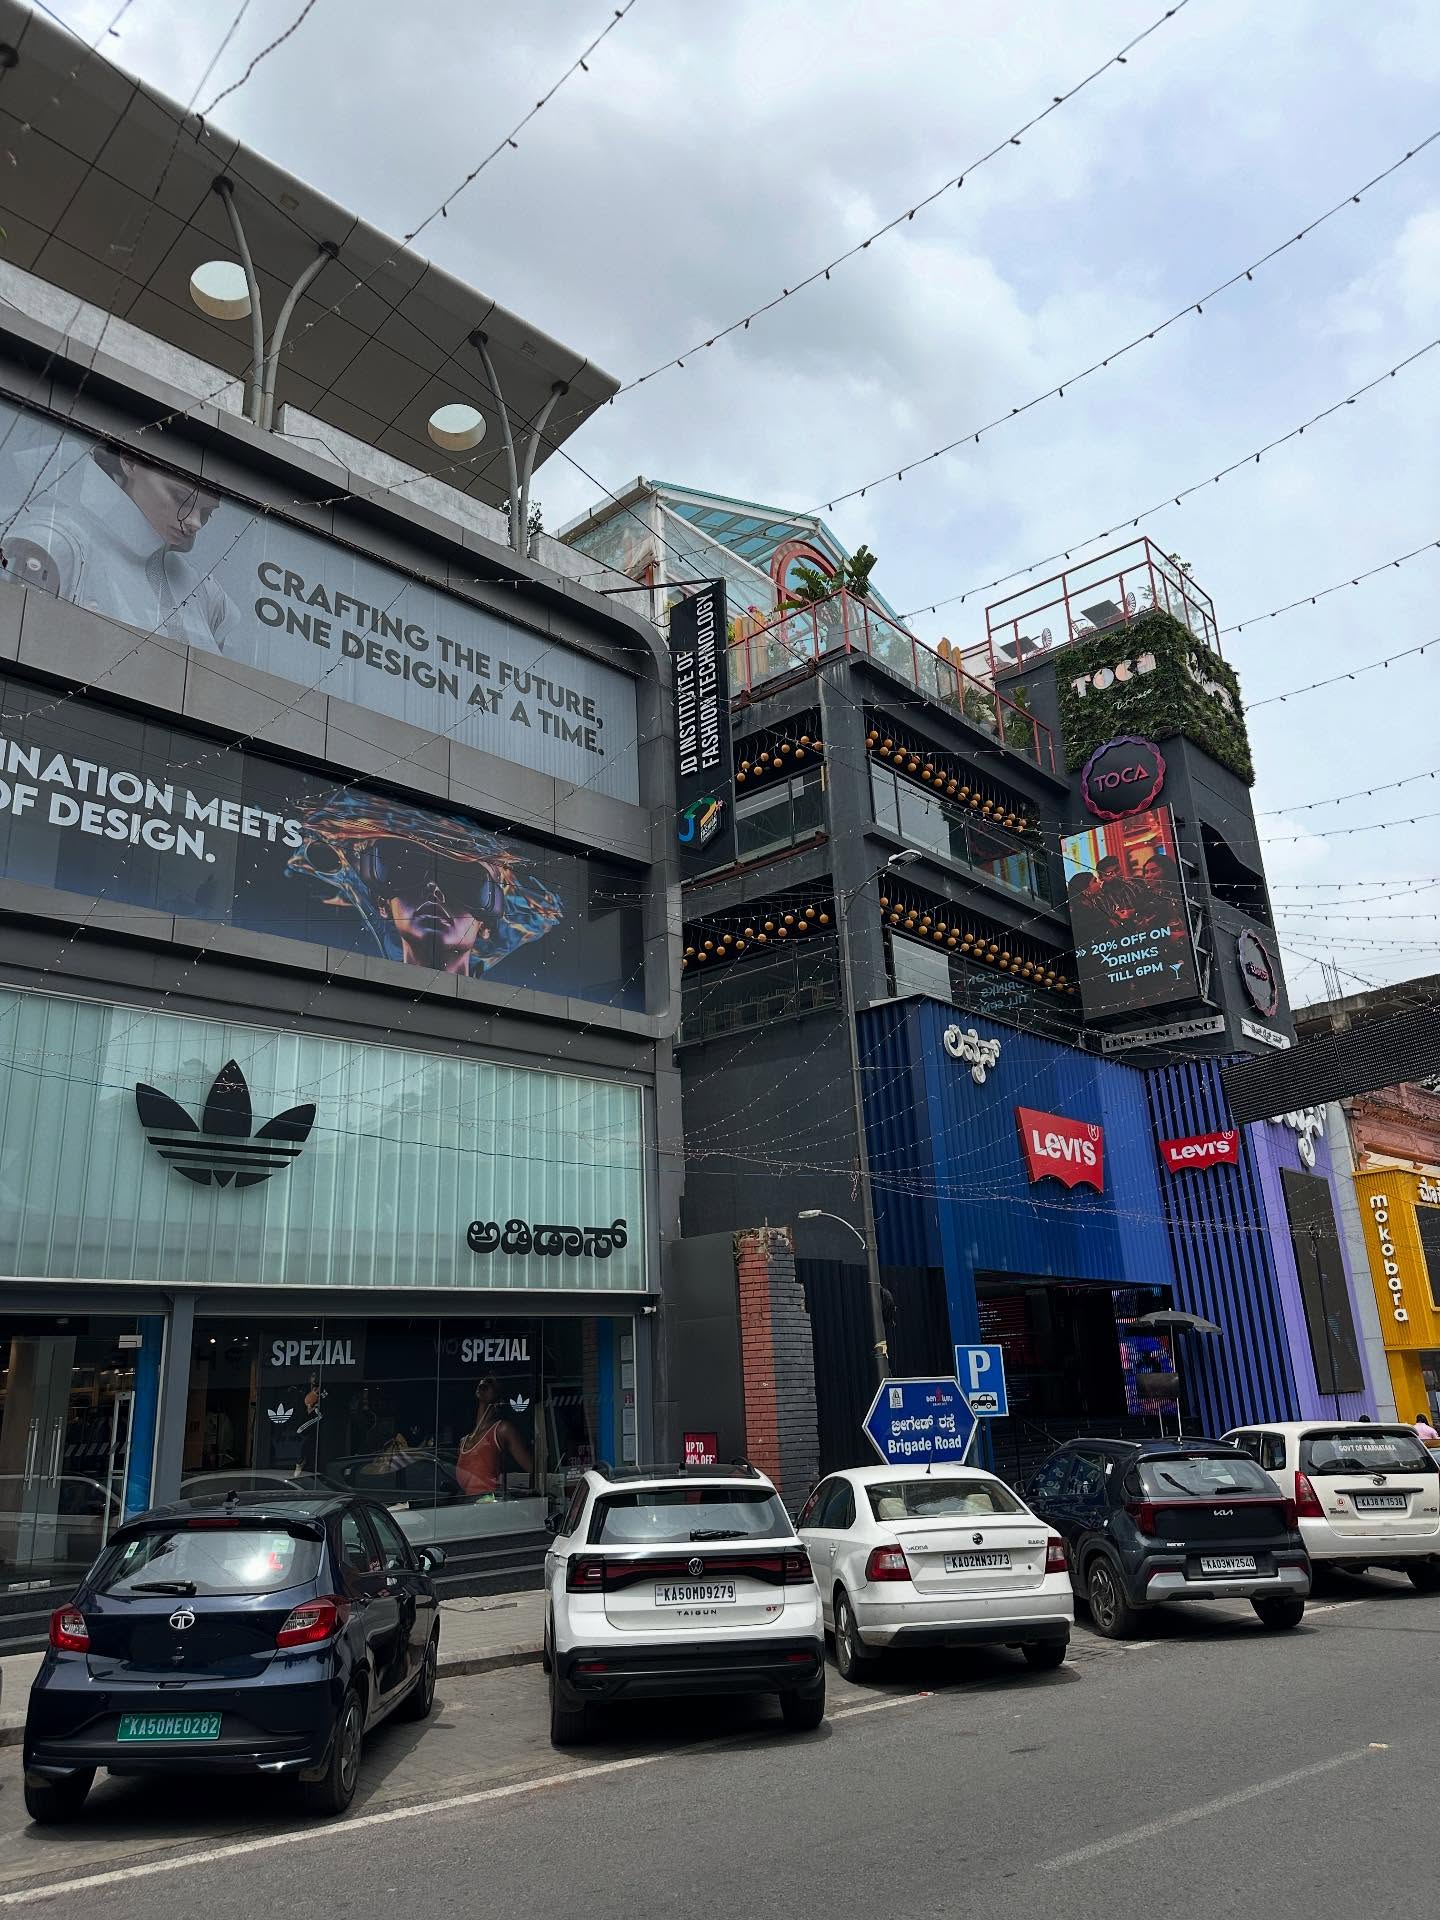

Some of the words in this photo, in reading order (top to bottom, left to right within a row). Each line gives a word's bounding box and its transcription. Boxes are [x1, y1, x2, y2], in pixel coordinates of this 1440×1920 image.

[257, 561, 429, 652] CRAFTING
[436, 635, 490, 679] THE
[498, 660, 604, 729] FUTURE,
[697, 592, 717, 695] TECHNOLOGY
[676, 649, 694, 671] OF
[254, 597, 331, 649] ONE
[341, 630, 458, 700] DESIGN
[466, 683, 504, 714] AT
[509, 700, 531, 728] A
[538, 708, 604, 756] TIME.
[678, 671, 697, 754] INSTITUTE
[700, 696, 720, 769] FASHION
[680, 755, 698, 776] JD
[1094, 761, 1149, 792] TOCA
[49, 792, 216, 863] DESIGN.
[185, 789, 303, 848] MEETS
[1091, 941, 1118, 955] 20%
[1120, 932, 1147, 946] OFF
[1150, 926, 1171, 940] ON
[1108, 947, 1159, 968] DRINKS
[1108, 970, 1134, 983] TILL
[1136, 962, 1163, 977] 6PM
[467, 1218, 628, 1259] ಅಡಿಡಾಸ್
[1369, 1195, 1409, 1322] mokobara
[271, 1339, 356, 1366] SPEZIAL
[460, 1338, 531, 1363] SPEZIAL
[967, 1350, 991, 1389] P
[938, 1413, 956, 1433] ರಸ್ತೆ
[685, 1441, 695, 1453] UP
[695, 1441, 704, 1453] TO
[888, 1436, 932, 1456] Brigade
[934, 1434, 962, 1450] Road
[663, 1584, 734, 1602] KA50MD9279
[676, 1608, 718, 1616] TAIGUN
[129, 1717, 218, 1735] KA50ME0282
